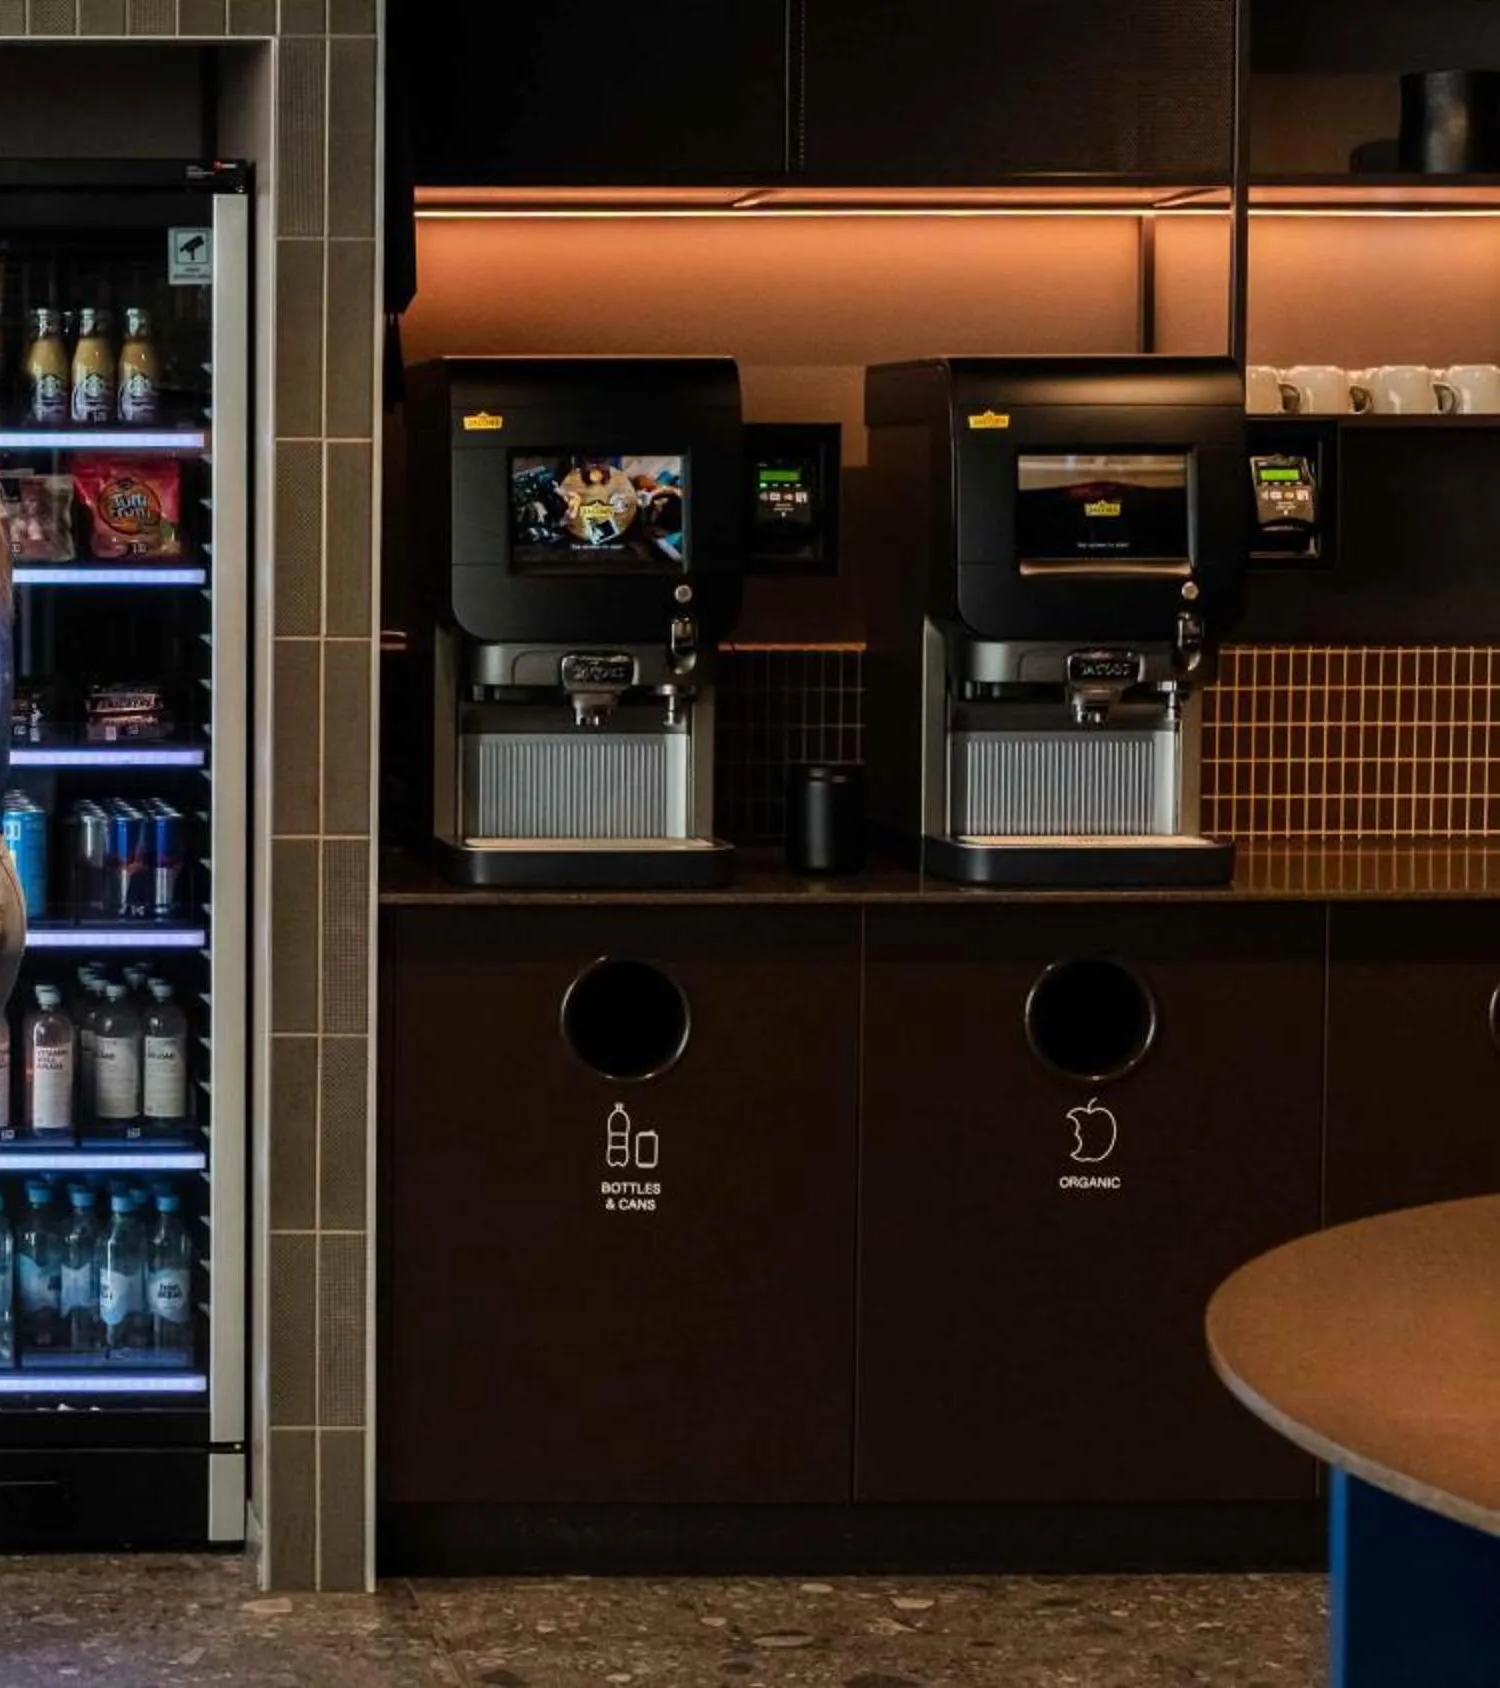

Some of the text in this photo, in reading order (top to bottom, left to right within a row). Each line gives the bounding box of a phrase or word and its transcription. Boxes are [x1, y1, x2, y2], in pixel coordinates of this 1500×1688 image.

[601, 1181, 661, 1195] BOTTLES
[1059, 1175, 1121, 1189] ORGANIC
[605, 1197, 656, 1211] & CANS
